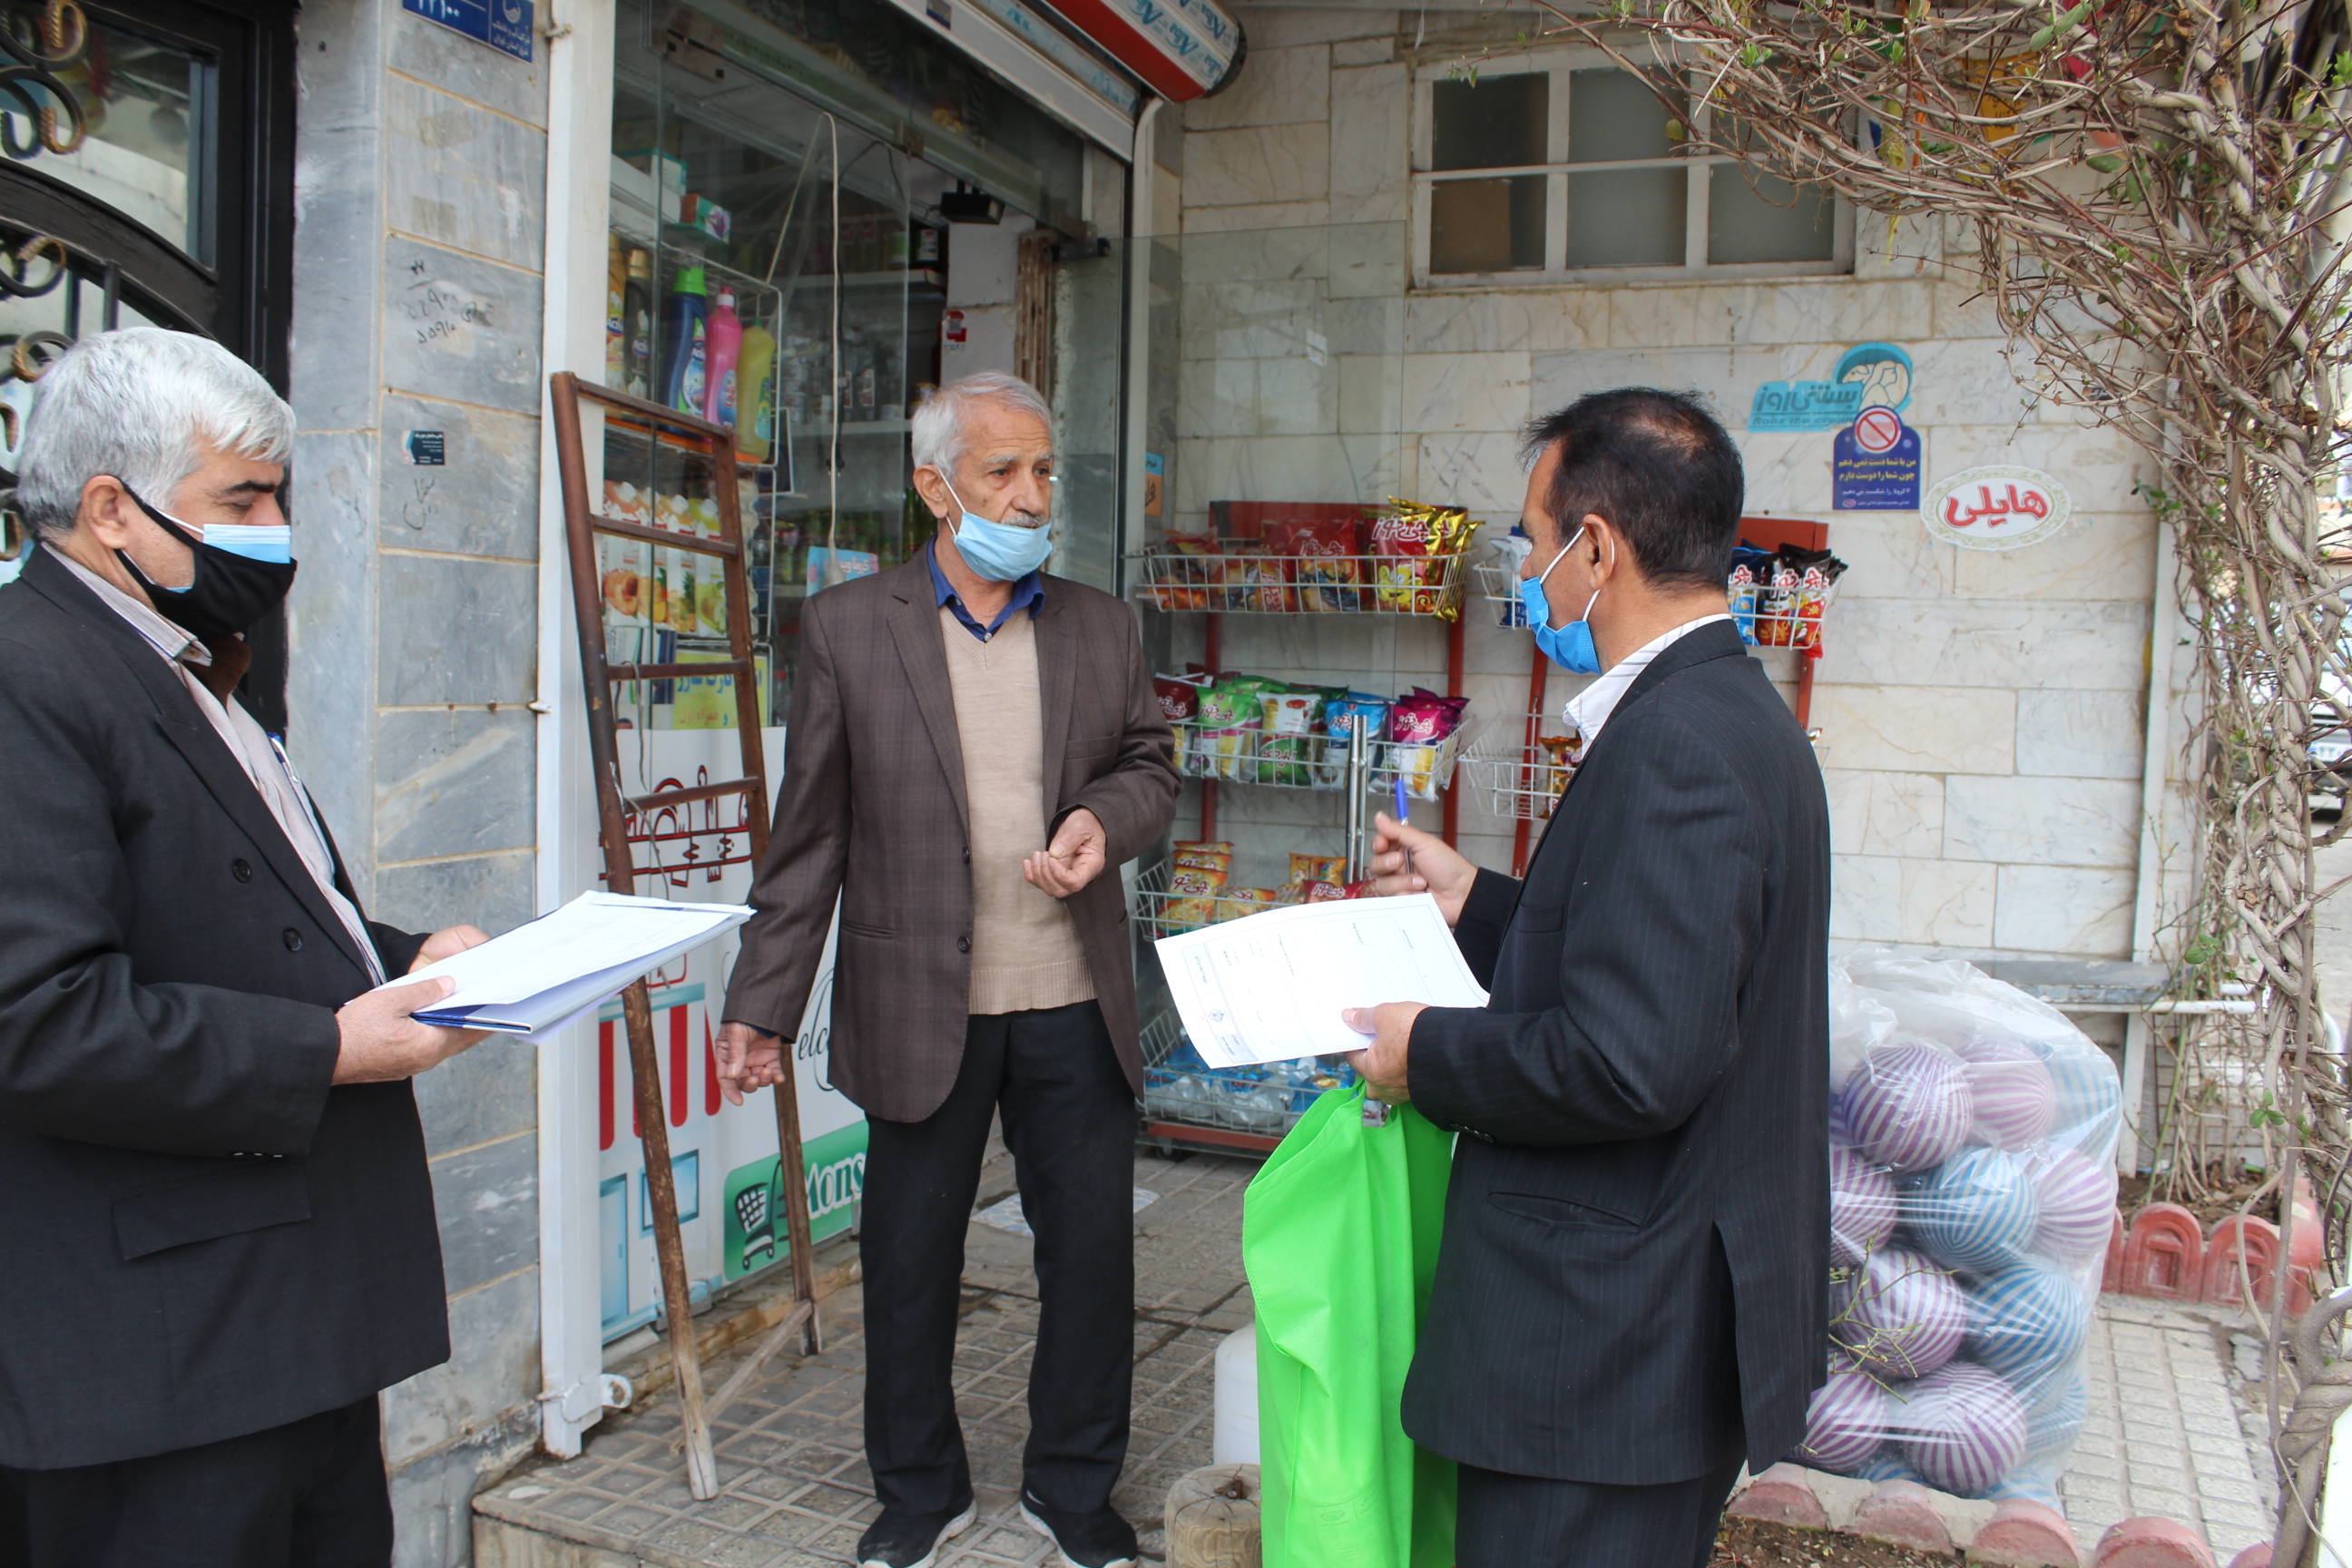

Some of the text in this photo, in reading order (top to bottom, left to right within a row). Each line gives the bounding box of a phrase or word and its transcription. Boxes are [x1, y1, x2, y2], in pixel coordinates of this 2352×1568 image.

[1868, 458, 1886, 466] دست
[1886, 457, 1899, 466] شما
[1886, 471, 1898, 479] شما
[1945, 484, 2048, 527] هایلی
